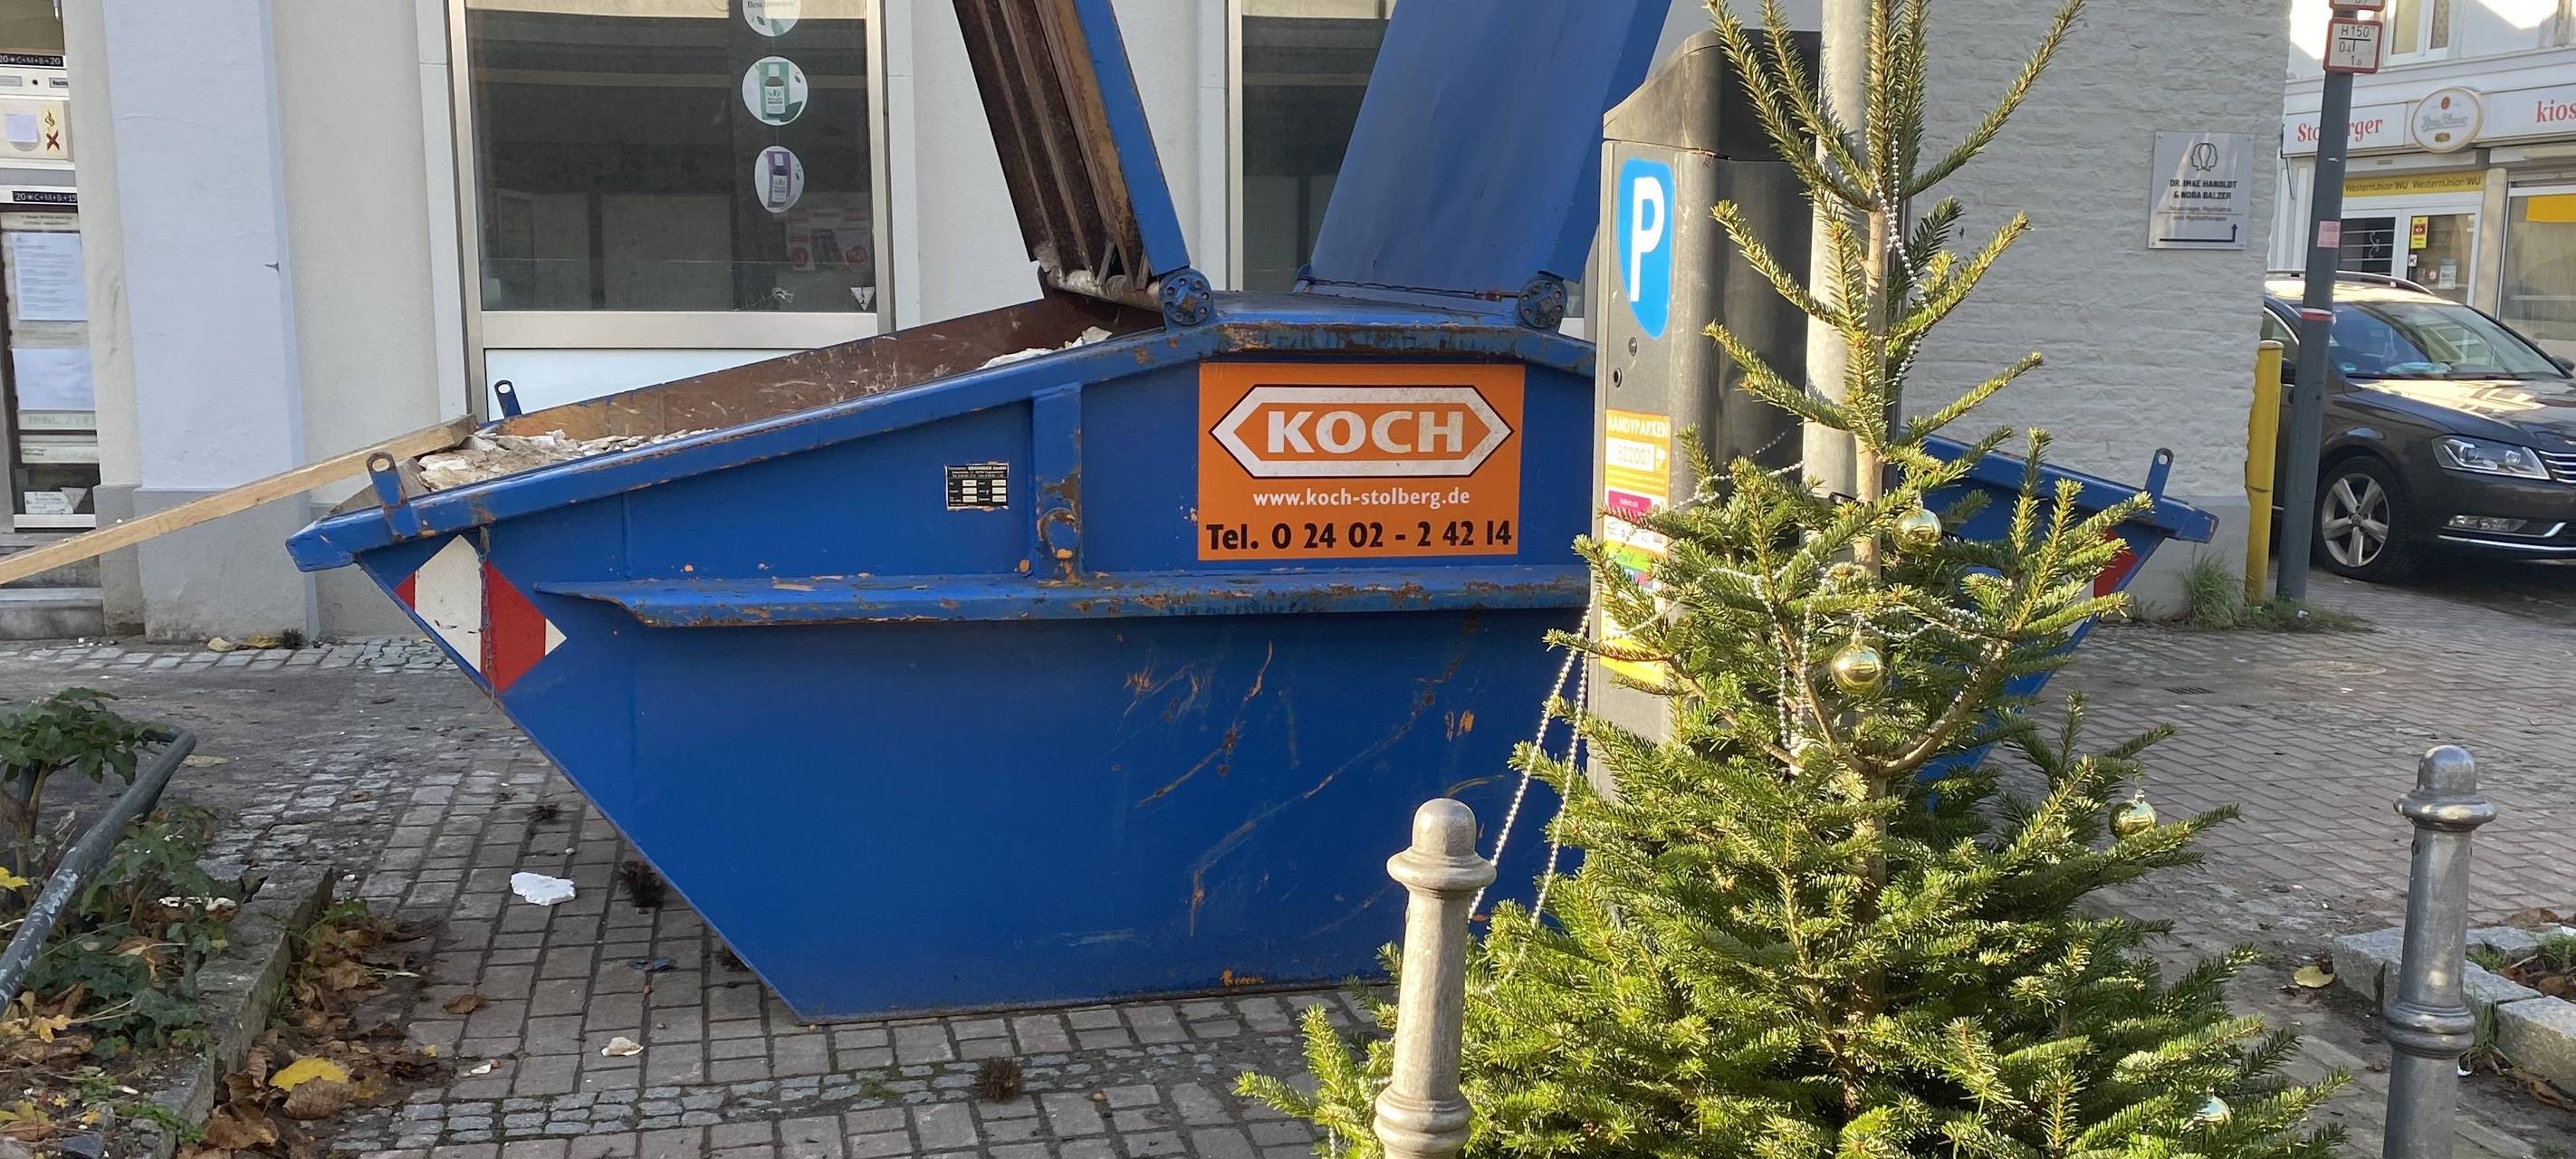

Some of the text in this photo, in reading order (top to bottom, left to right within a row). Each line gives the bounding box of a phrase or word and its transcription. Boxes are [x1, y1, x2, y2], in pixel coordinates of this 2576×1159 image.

[2297, 119, 2383, 142] Storger
[2181, 191, 2201, 199] NORA
[2202, 191, 2232, 200] BALZER
[1630, 177, 1665, 302] P
[1268, 410, 1463, 453] KOCH
[1253, 487, 1470, 510] www.koch-stolberg.de
[1206, 523, 1259, 550] Tel.
[1271, 522, 1291, 549] 0
[1304, 522, 1336, 548] 24
[1348, 522, 1384, 548] 02
[1417, 522, 1432, 547] 2
[1442, 521, 1474, 546] 42
[1486, 521, 1512, 546] 14
